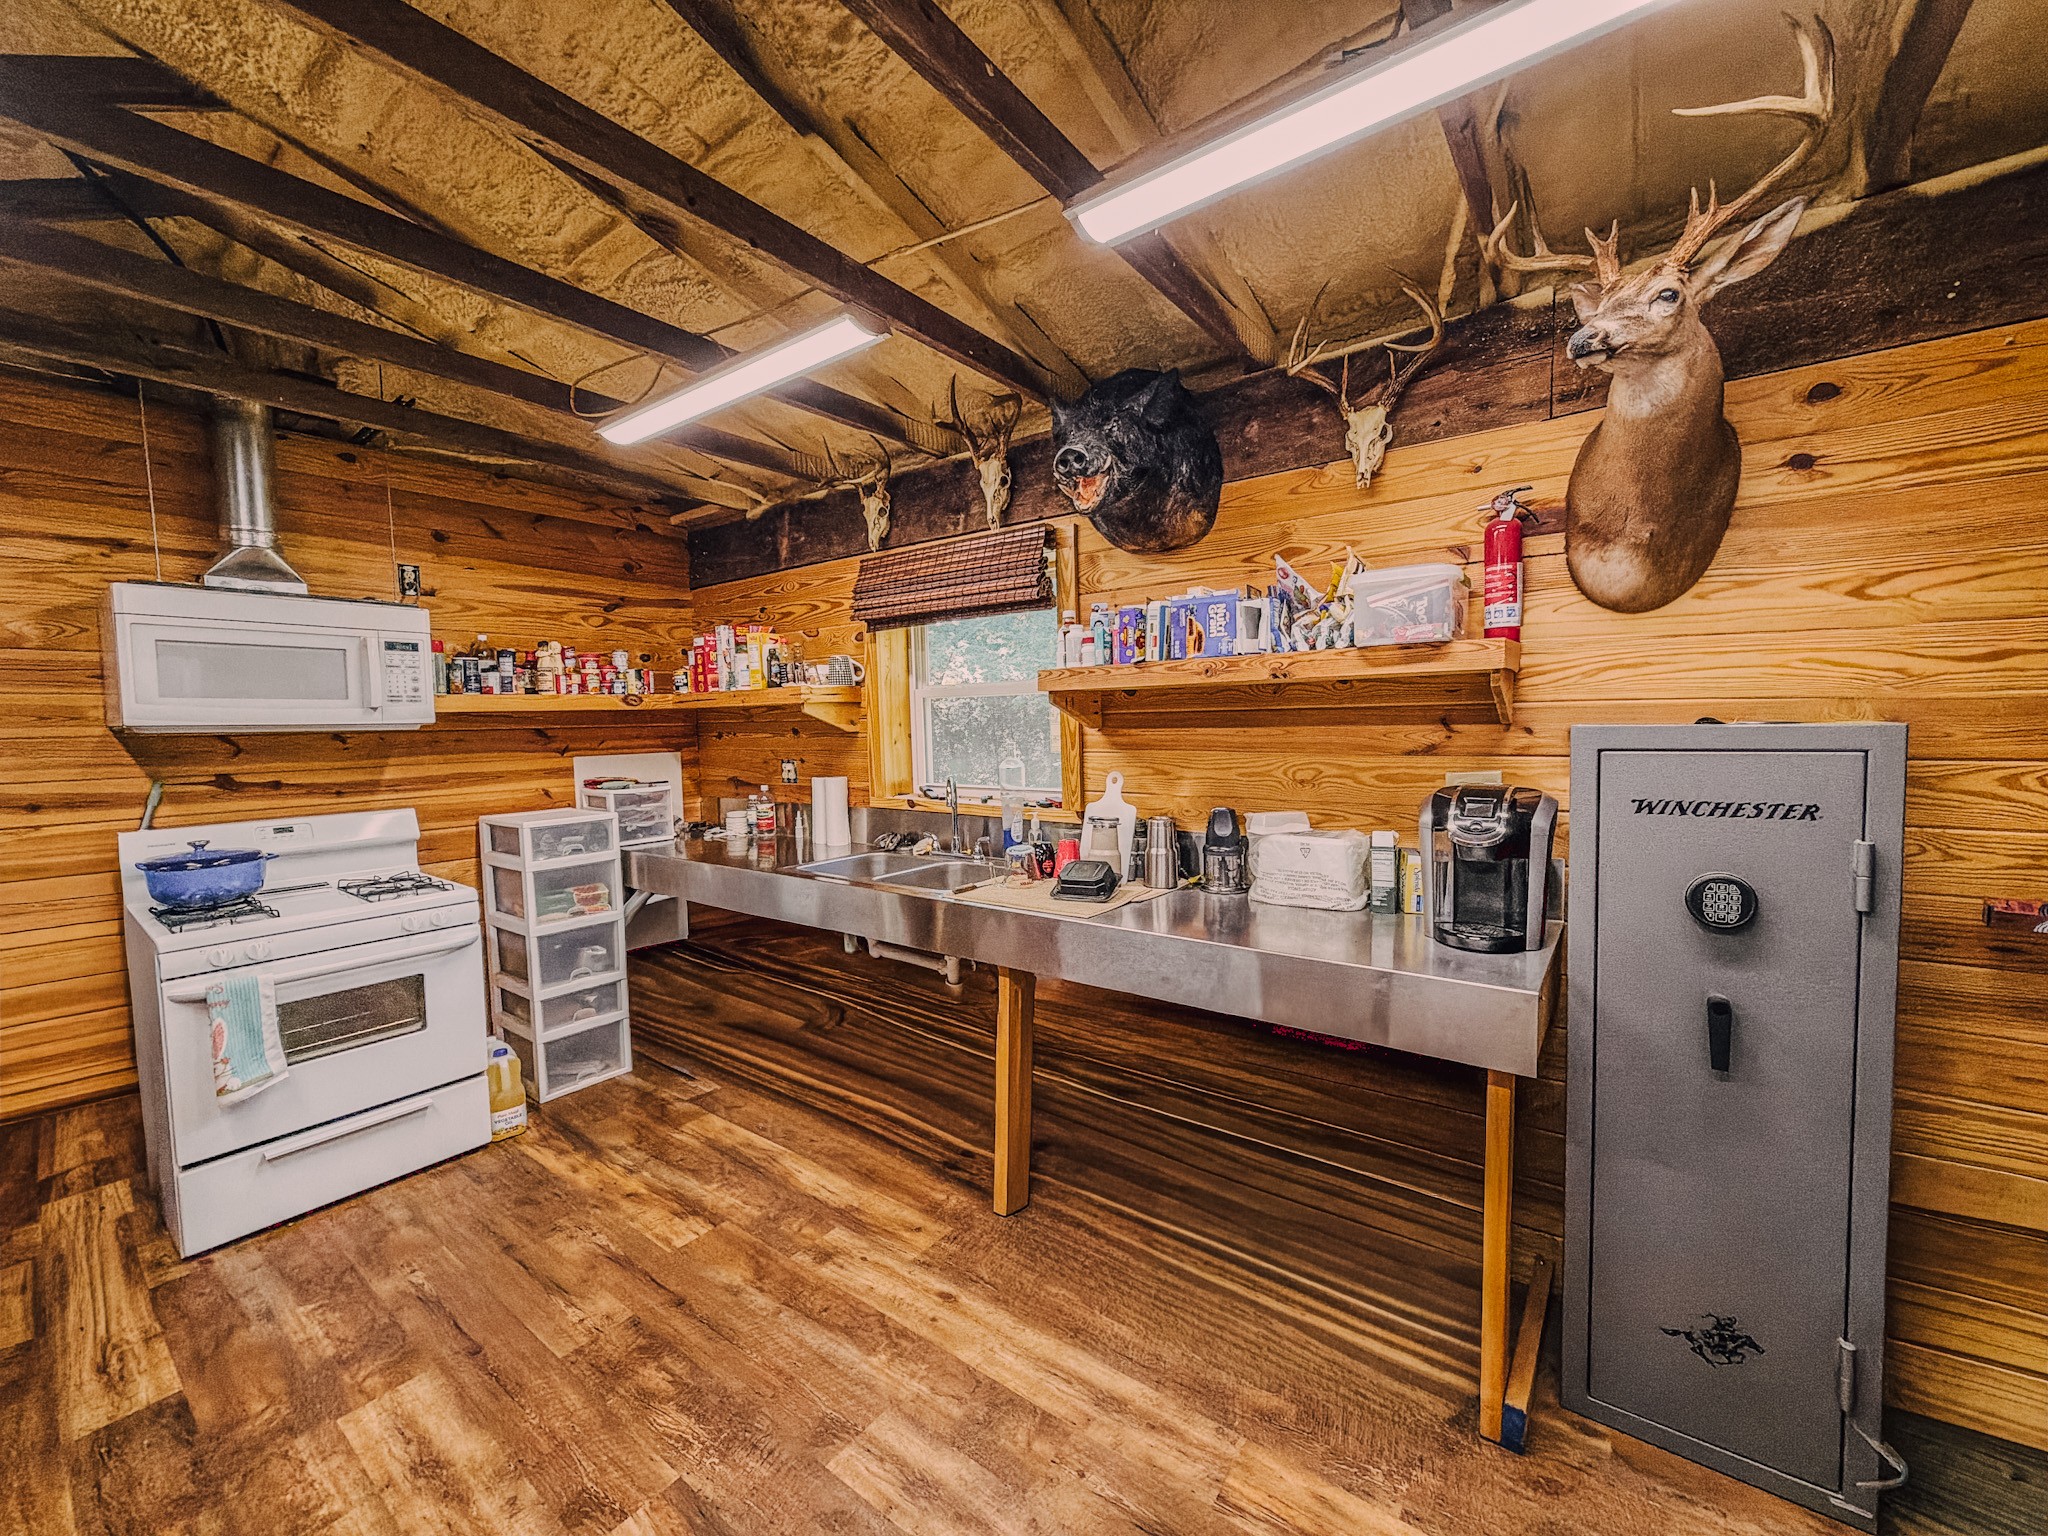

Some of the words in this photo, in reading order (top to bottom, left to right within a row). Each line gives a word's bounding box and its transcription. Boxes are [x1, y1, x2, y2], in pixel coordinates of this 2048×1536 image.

[1208, 604, 1217, 637] Grain
[1216, 603, 1228, 637] Nutri
[1631, 799, 1820, 821] WINCHESTER
[1413, 867, 1422, 892] Splenda
